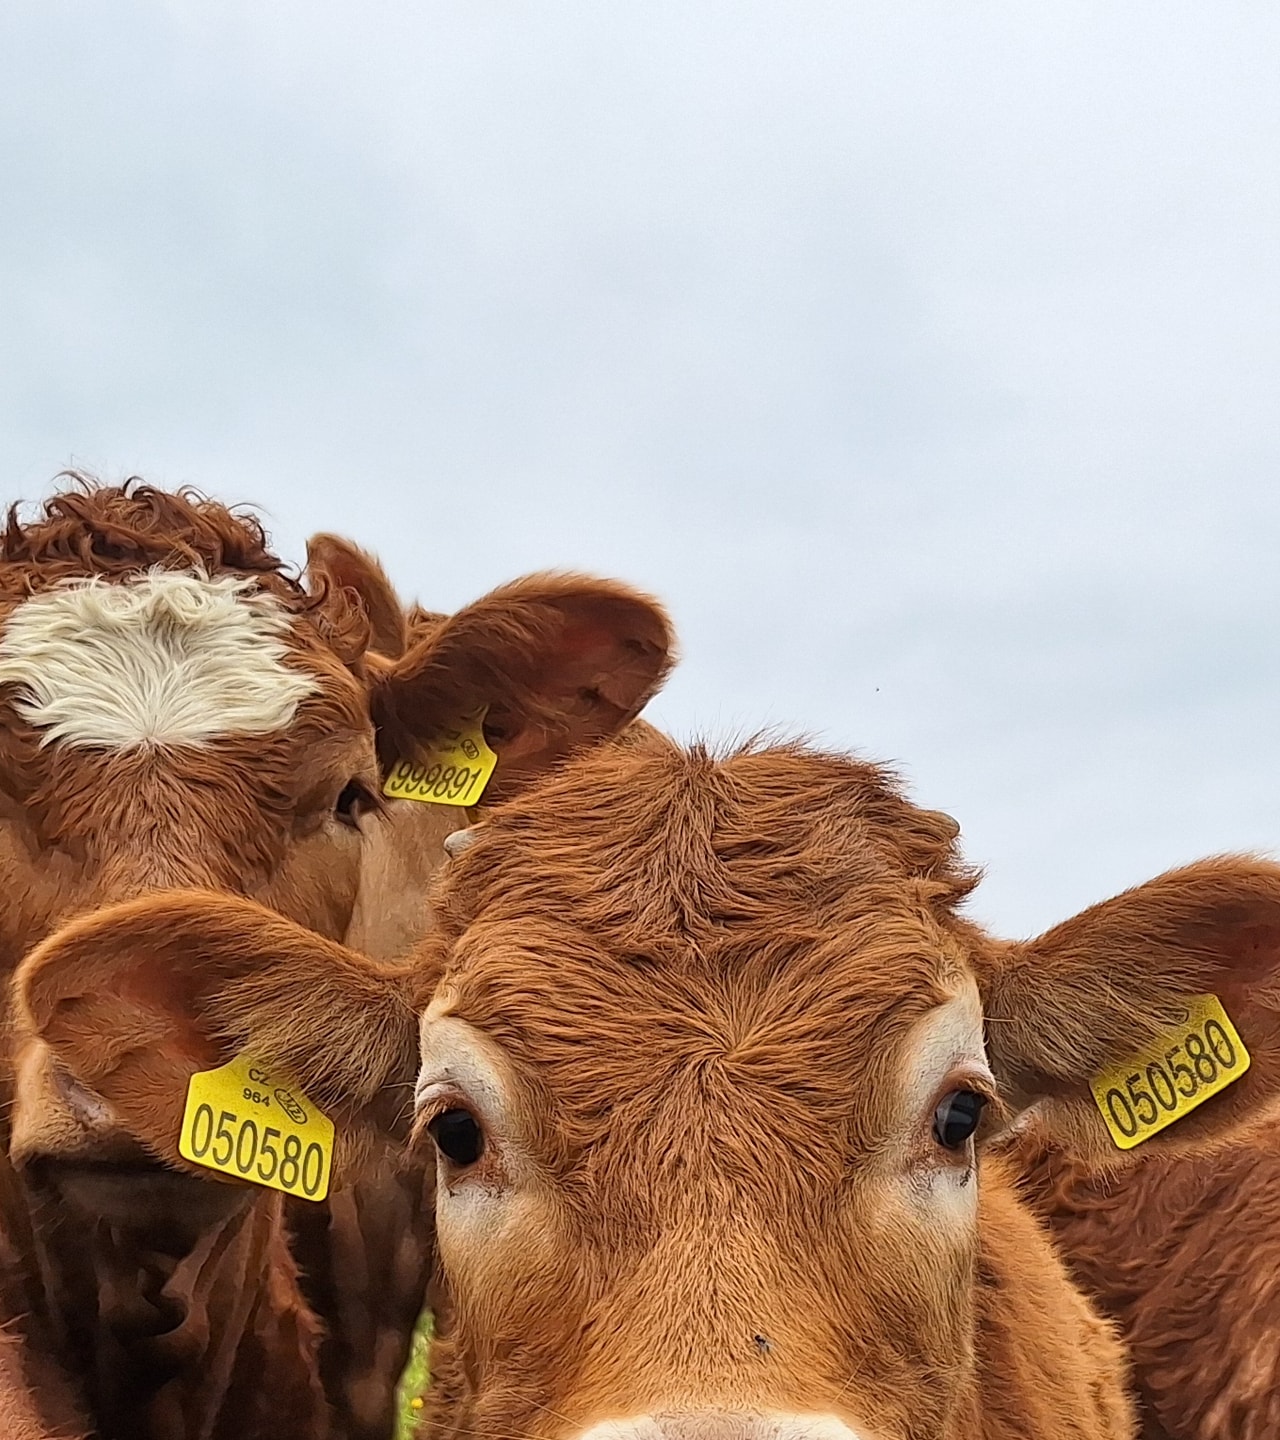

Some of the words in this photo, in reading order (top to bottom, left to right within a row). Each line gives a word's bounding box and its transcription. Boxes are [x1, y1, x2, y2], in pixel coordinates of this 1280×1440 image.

[391, 761, 482, 801] 999891
[242, 1088, 270, 1108] 964
[1106, 1019, 1236, 1138] 050580
[191, 1103, 324, 1197] 050580
